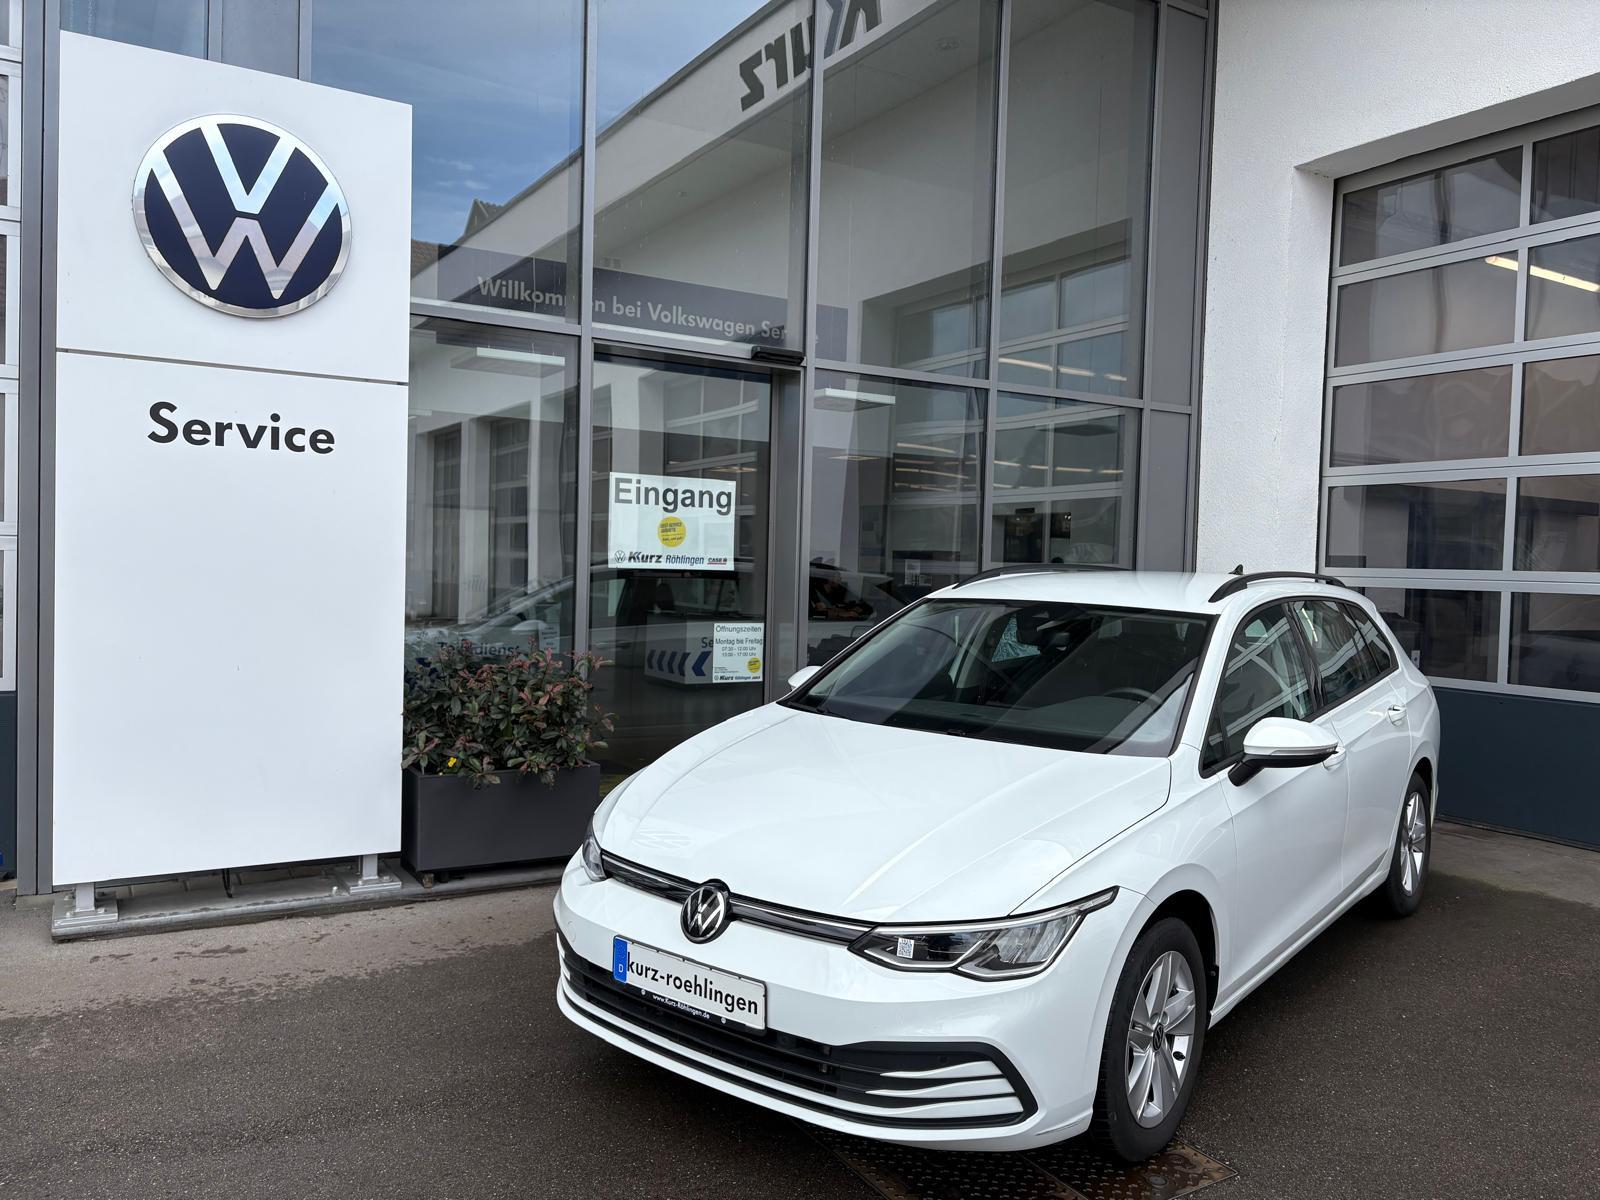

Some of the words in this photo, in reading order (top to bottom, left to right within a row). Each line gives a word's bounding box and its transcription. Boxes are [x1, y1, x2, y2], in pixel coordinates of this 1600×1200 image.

[477, 276, 606, 313] Willkomn
[612, 296, 643, 318] bei
[648, 302, 755, 337] Volkswagen
[147, 401, 335, 455] Service
[614, 477, 732, 516] Eingang
[628, 551, 662, 564] Kurz
[665, 554, 705, 567] Röhlingen
[715, 625, 762, 634] Öffnungszeiten
[715, 638, 735, 646] Montag
[745, 637, 763, 646] Freitag
[618, 963, 624, 973] D
[627, 951, 758, 1015] kurz-roehlingen
